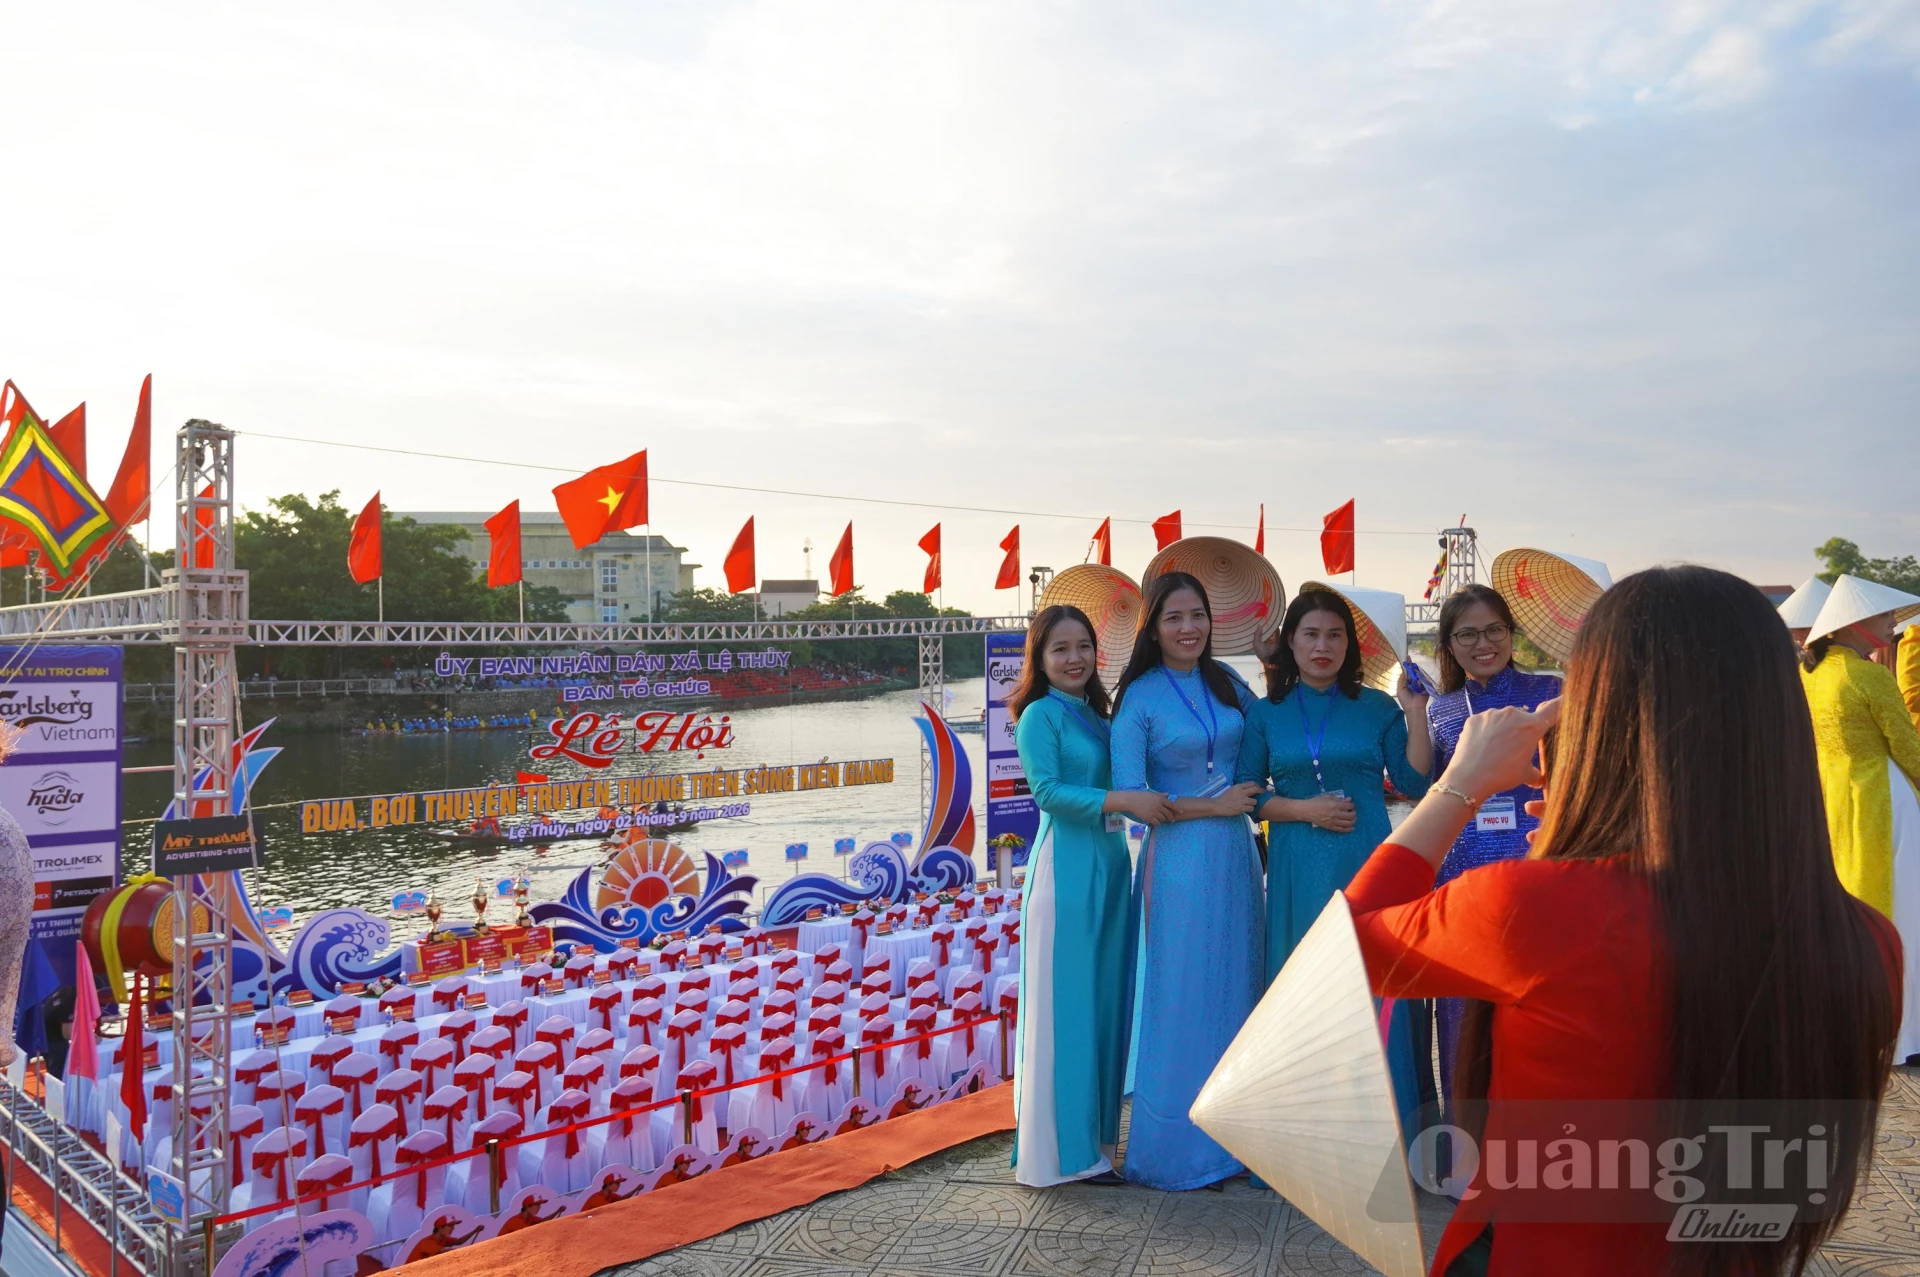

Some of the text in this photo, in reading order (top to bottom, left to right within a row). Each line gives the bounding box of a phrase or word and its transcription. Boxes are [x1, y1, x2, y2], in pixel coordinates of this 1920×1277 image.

[435, 647, 791, 677] ỦY BAN NHÂN DÂN XÃ LỆ THỦY
[563, 676, 711, 702] BAN TỔ CHỨC
[40, 726, 115, 740] Vietnam
[528, 711, 735, 769] Lễ Hội
[27, 785, 84, 806] huda
[301, 755, 894, 833] ĐUA, BƠI THUYỀN TRUYỀN THỐNG TRÊN SÔNG KIẾN GIANG
[508, 823, 527, 843] Lệ
[575, 818, 612, 836] ngày
[615, 815, 631, 829] 02
[635, 809, 676, 827] tháng
[689, 806, 719, 821] năm
[720, 802, 751, 818] 2026
